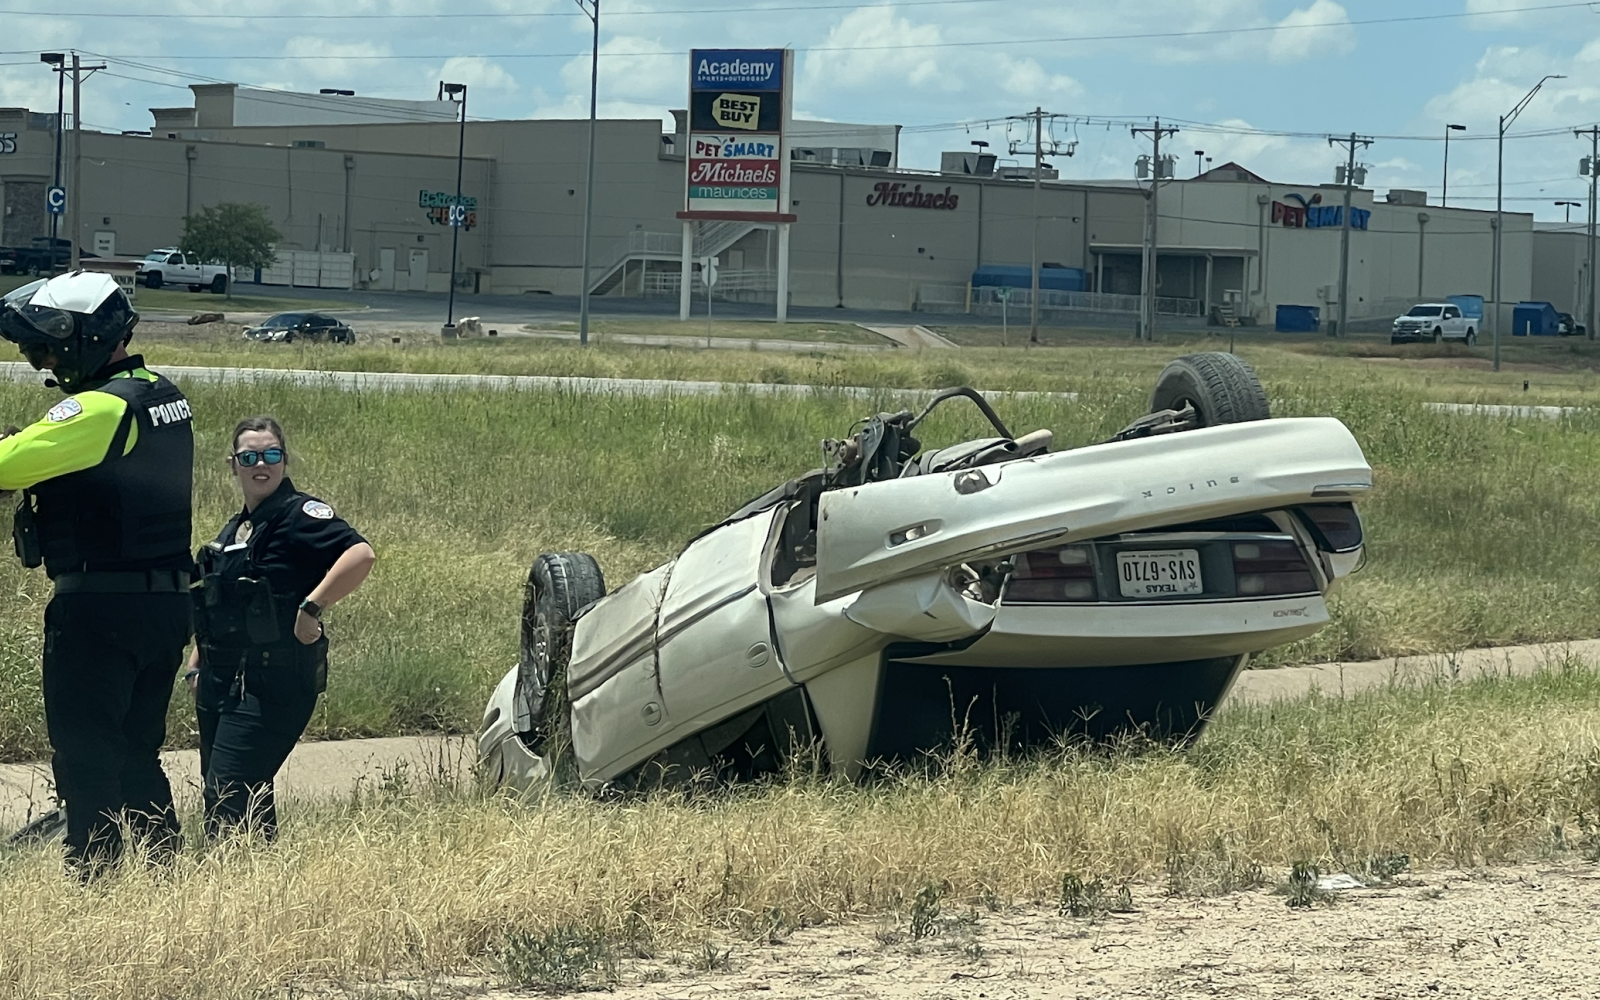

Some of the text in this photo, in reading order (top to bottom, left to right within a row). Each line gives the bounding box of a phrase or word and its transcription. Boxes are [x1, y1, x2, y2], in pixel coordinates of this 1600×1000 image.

[697, 59, 774, 80] Academy
[720, 99, 758, 112] BEST
[720, 111, 753, 123] BUY
[691, 163, 776, 183] Michaels
[49, 188, 65, 207] C
[698, 187, 767, 199] maurices
[866, 182, 959, 210] Michaels
[1141, 476, 1240, 498] BUICK
[1145, 584, 1177, 593] TEXAS
